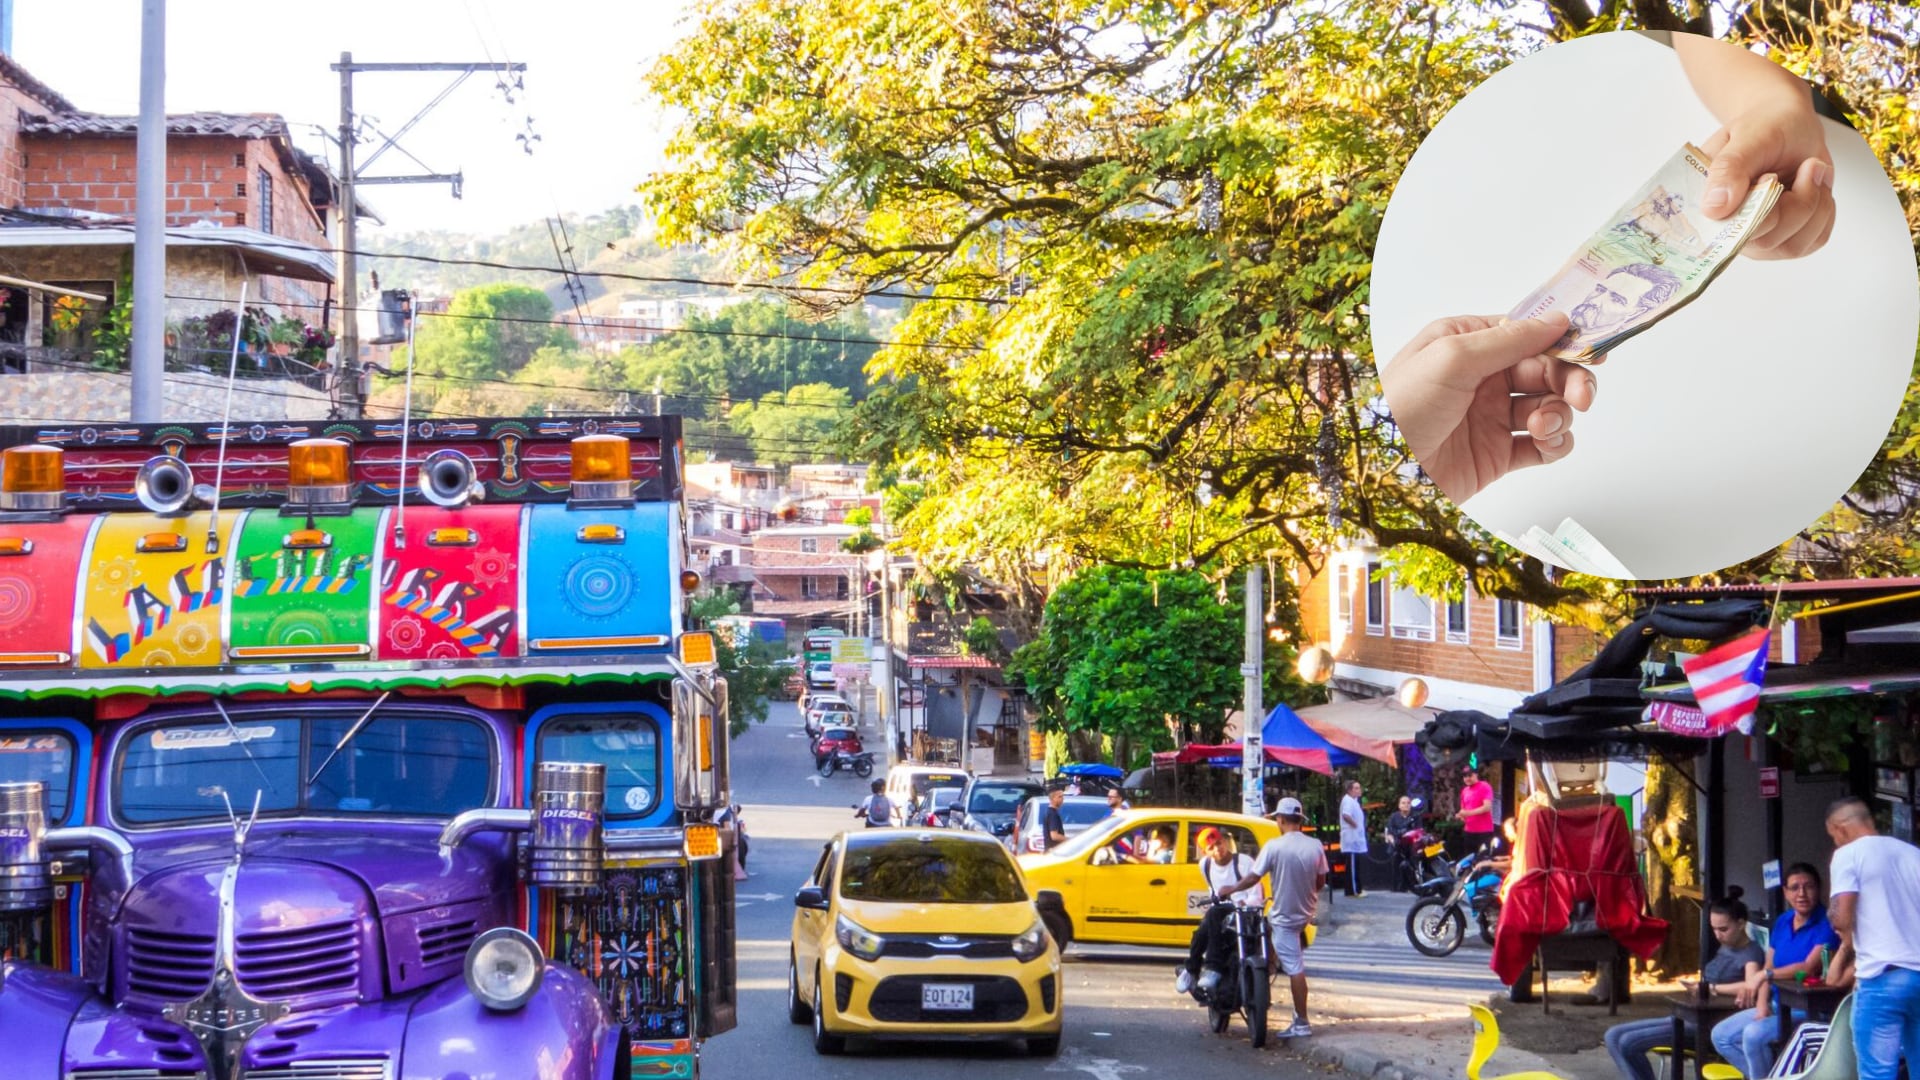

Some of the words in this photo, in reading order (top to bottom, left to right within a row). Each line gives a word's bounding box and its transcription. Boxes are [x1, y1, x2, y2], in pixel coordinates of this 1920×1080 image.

[87, 583, 172, 664] LA
[628, 789, 649, 807] 32
[542, 808, 594, 821] DIESEL
